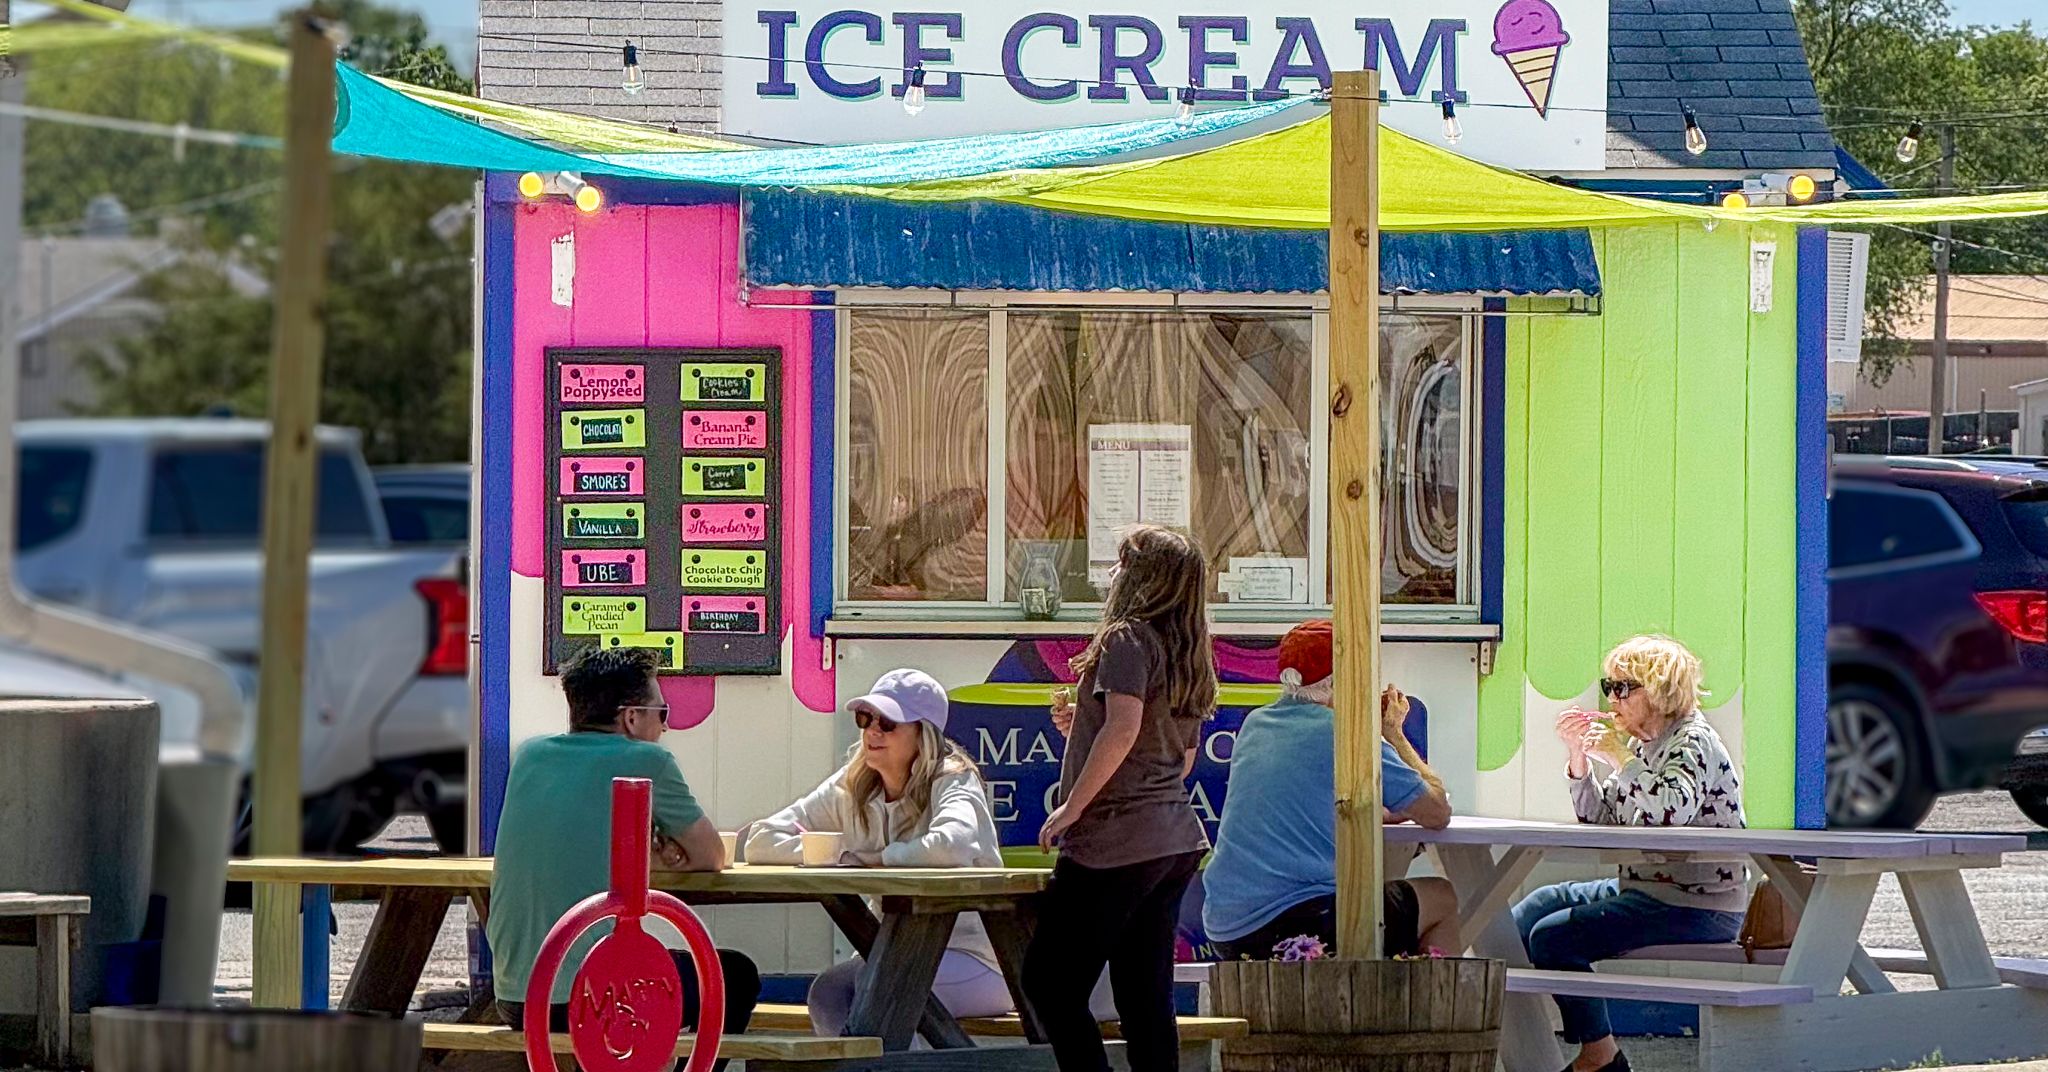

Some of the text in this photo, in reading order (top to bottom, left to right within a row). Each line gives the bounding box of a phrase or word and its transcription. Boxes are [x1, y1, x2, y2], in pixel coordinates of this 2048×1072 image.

[756, 10, 1469, 104] ICE CREAM
[580, 377, 629, 388] Lemon
[564, 384, 642, 400] Poppyseed
[702, 421, 750, 433] Banana
[694, 433, 757, 446] Cream Pie
[1097, 440, 1131, 450] MENU
[581, 473, 627, 490] SMORE'S
[578, 520, 622, 535] VANILLA
[687, 518, 761, 539] Strawberry
[586, 564, 619, 582] UBE
[685, 565, 763, 576] Chocolate Chip
[687, 575, 760, 586] Cookie Dough
[582, 601, 627, 614] Caramel
[582, 610, 625, 622] Candied
[700, 613, 739, 622] BIRTHDAY
[588, 620, 619, 631] Pecan
